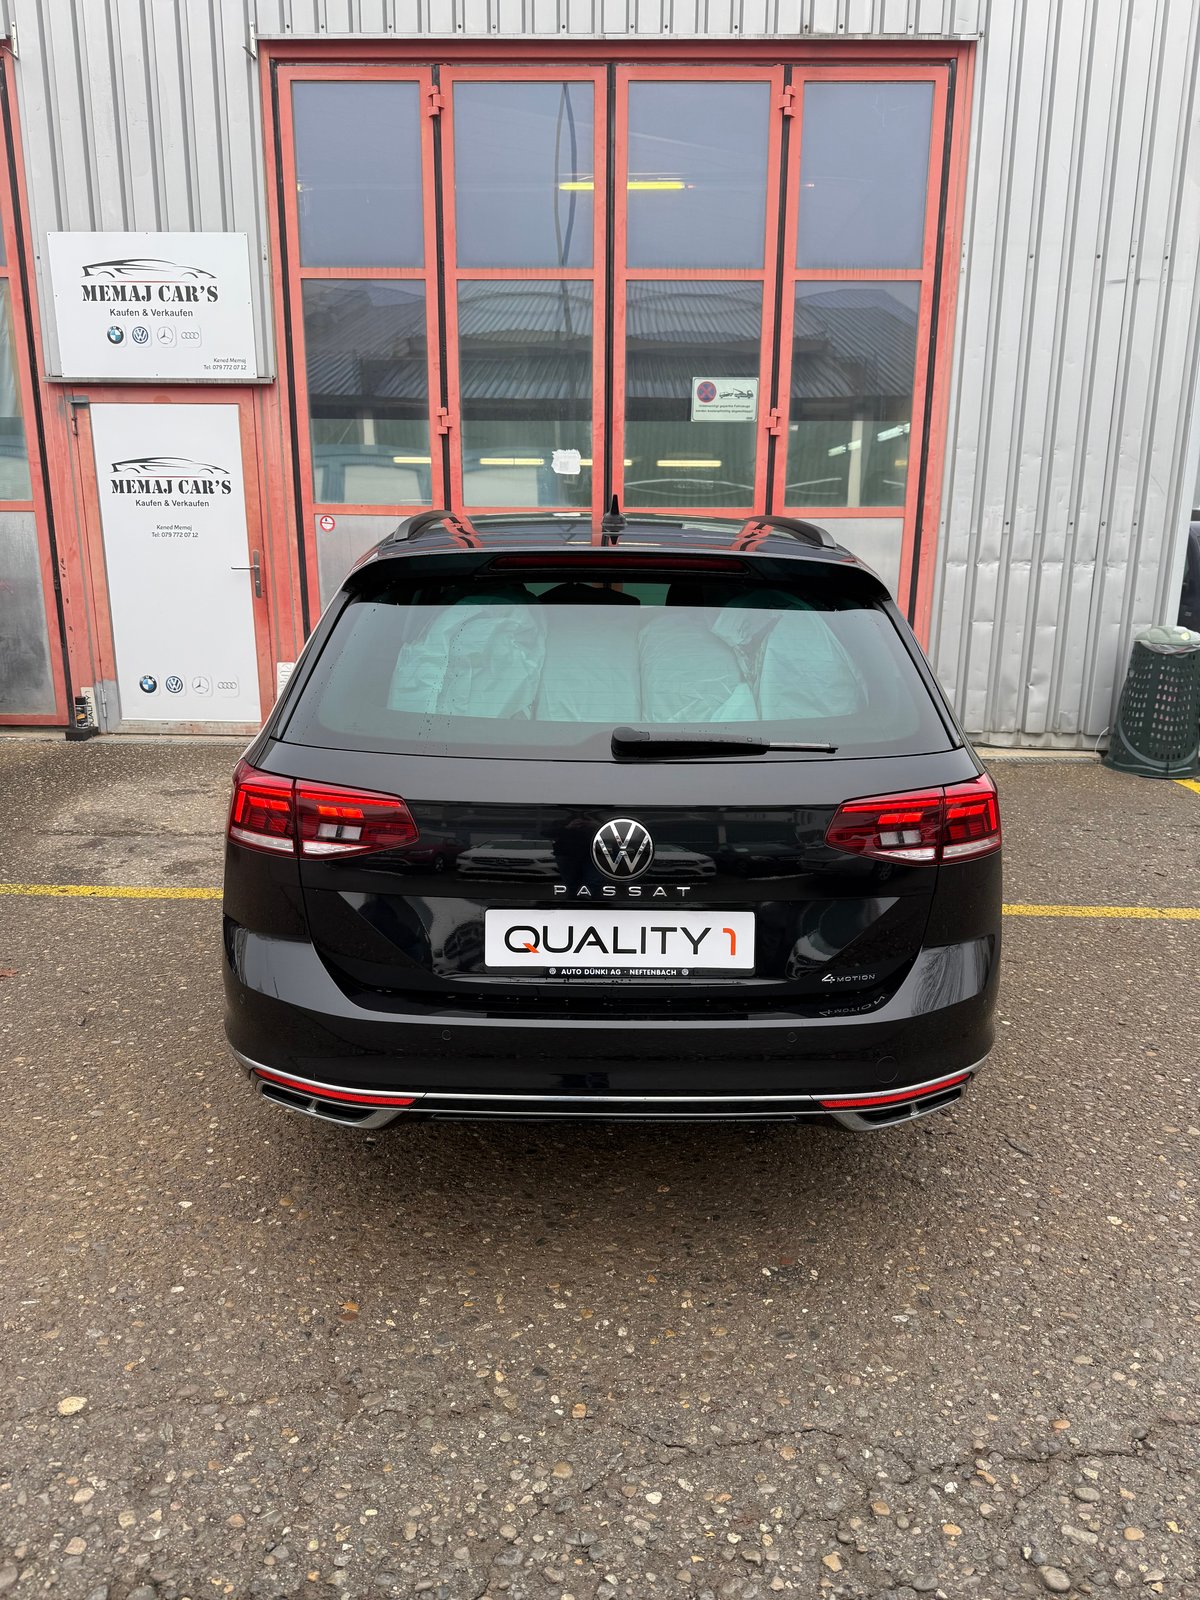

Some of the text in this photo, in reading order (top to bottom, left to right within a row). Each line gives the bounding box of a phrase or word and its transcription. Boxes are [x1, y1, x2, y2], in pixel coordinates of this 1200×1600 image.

[81, 285, 219, 303] MEMAJ CAR'S
[109, 308, 194, 318] Kaufen & Verkaufen
[110, 479, 232, 495] MEMAJ CAR'S
[135, 499, 162, 507] Kaufen
[172, 499, 210, 507] Verkaufen
[174, 524, 193, 532] Memaj
[553, 885, 692, 897] PASSAT
[504, 925, 737, 955] QUALITY 1
[584, 967, 608, 975] DÜNKI
[629, 968, 677, 976] NEFTENBACH
[821, 973, 876, 984] 4MOTION
